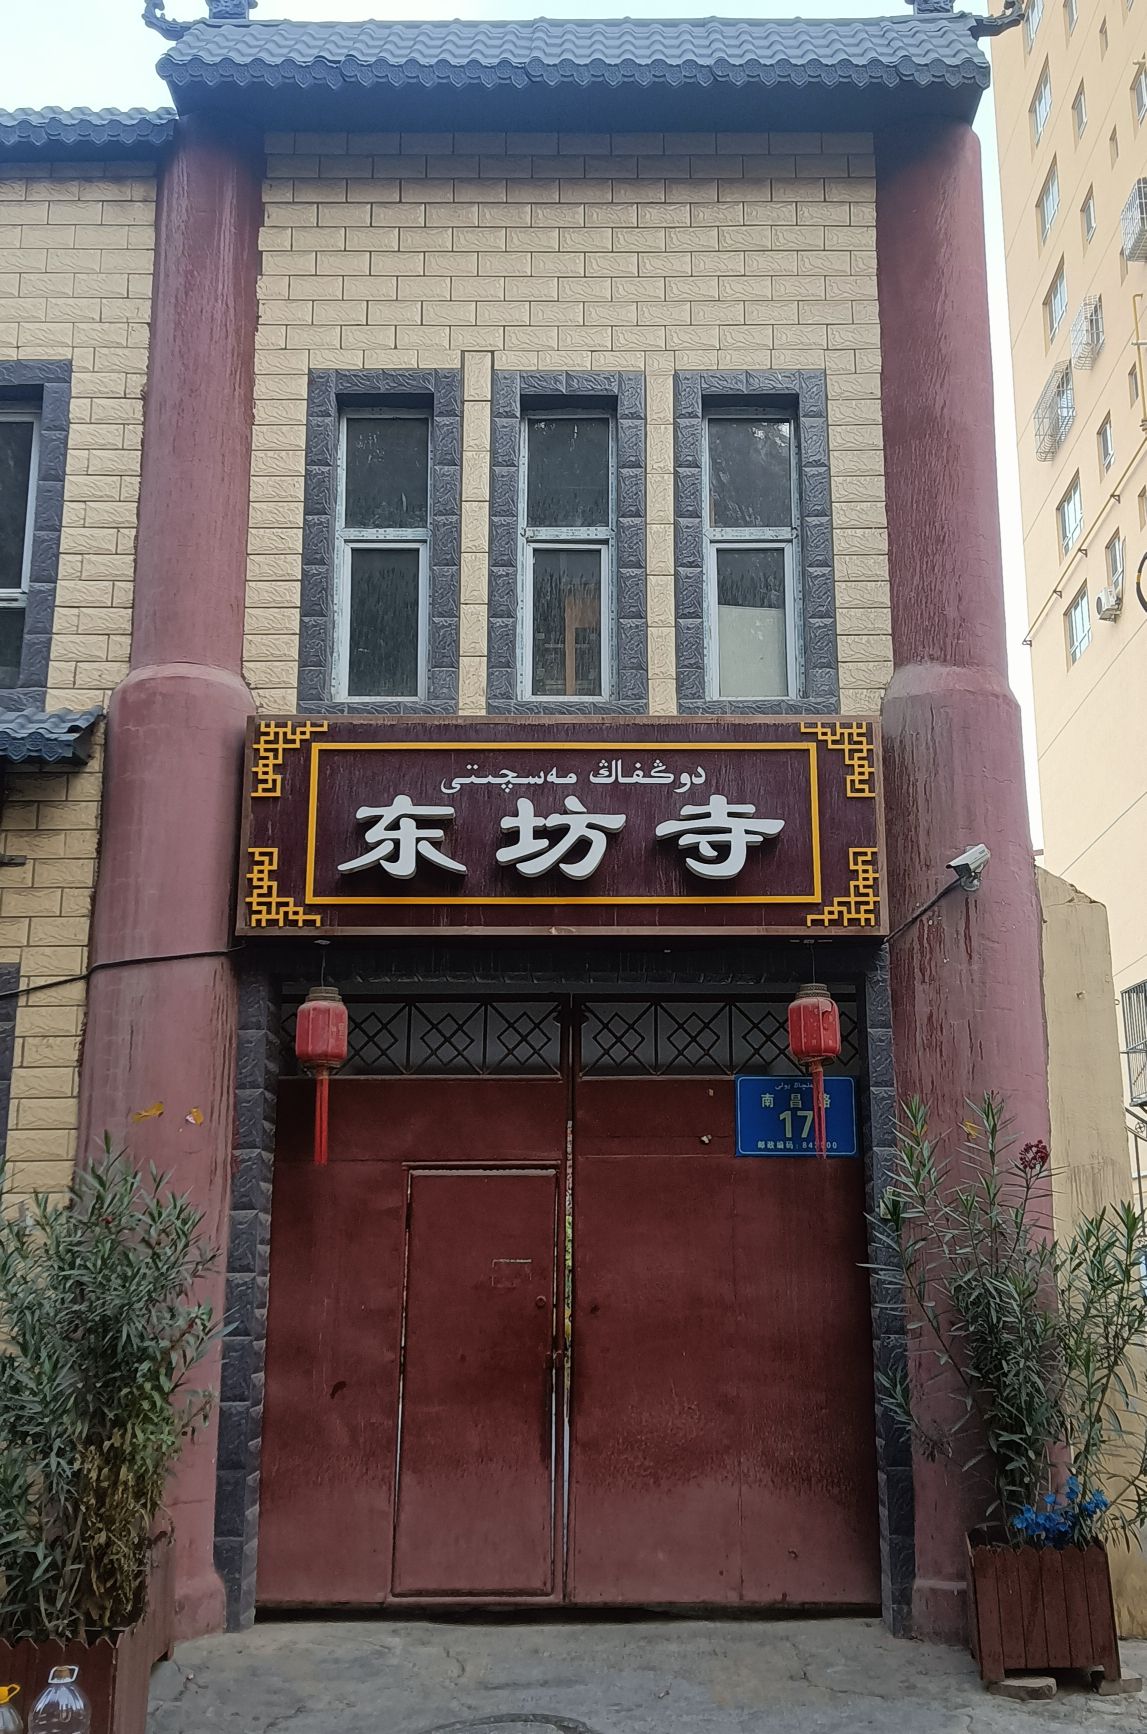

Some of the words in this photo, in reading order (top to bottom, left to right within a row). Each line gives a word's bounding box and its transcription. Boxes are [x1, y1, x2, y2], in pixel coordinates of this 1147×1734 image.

[337, 794, 786, 881] 东坊寺
[779, 1110, 815, 1138] 17
